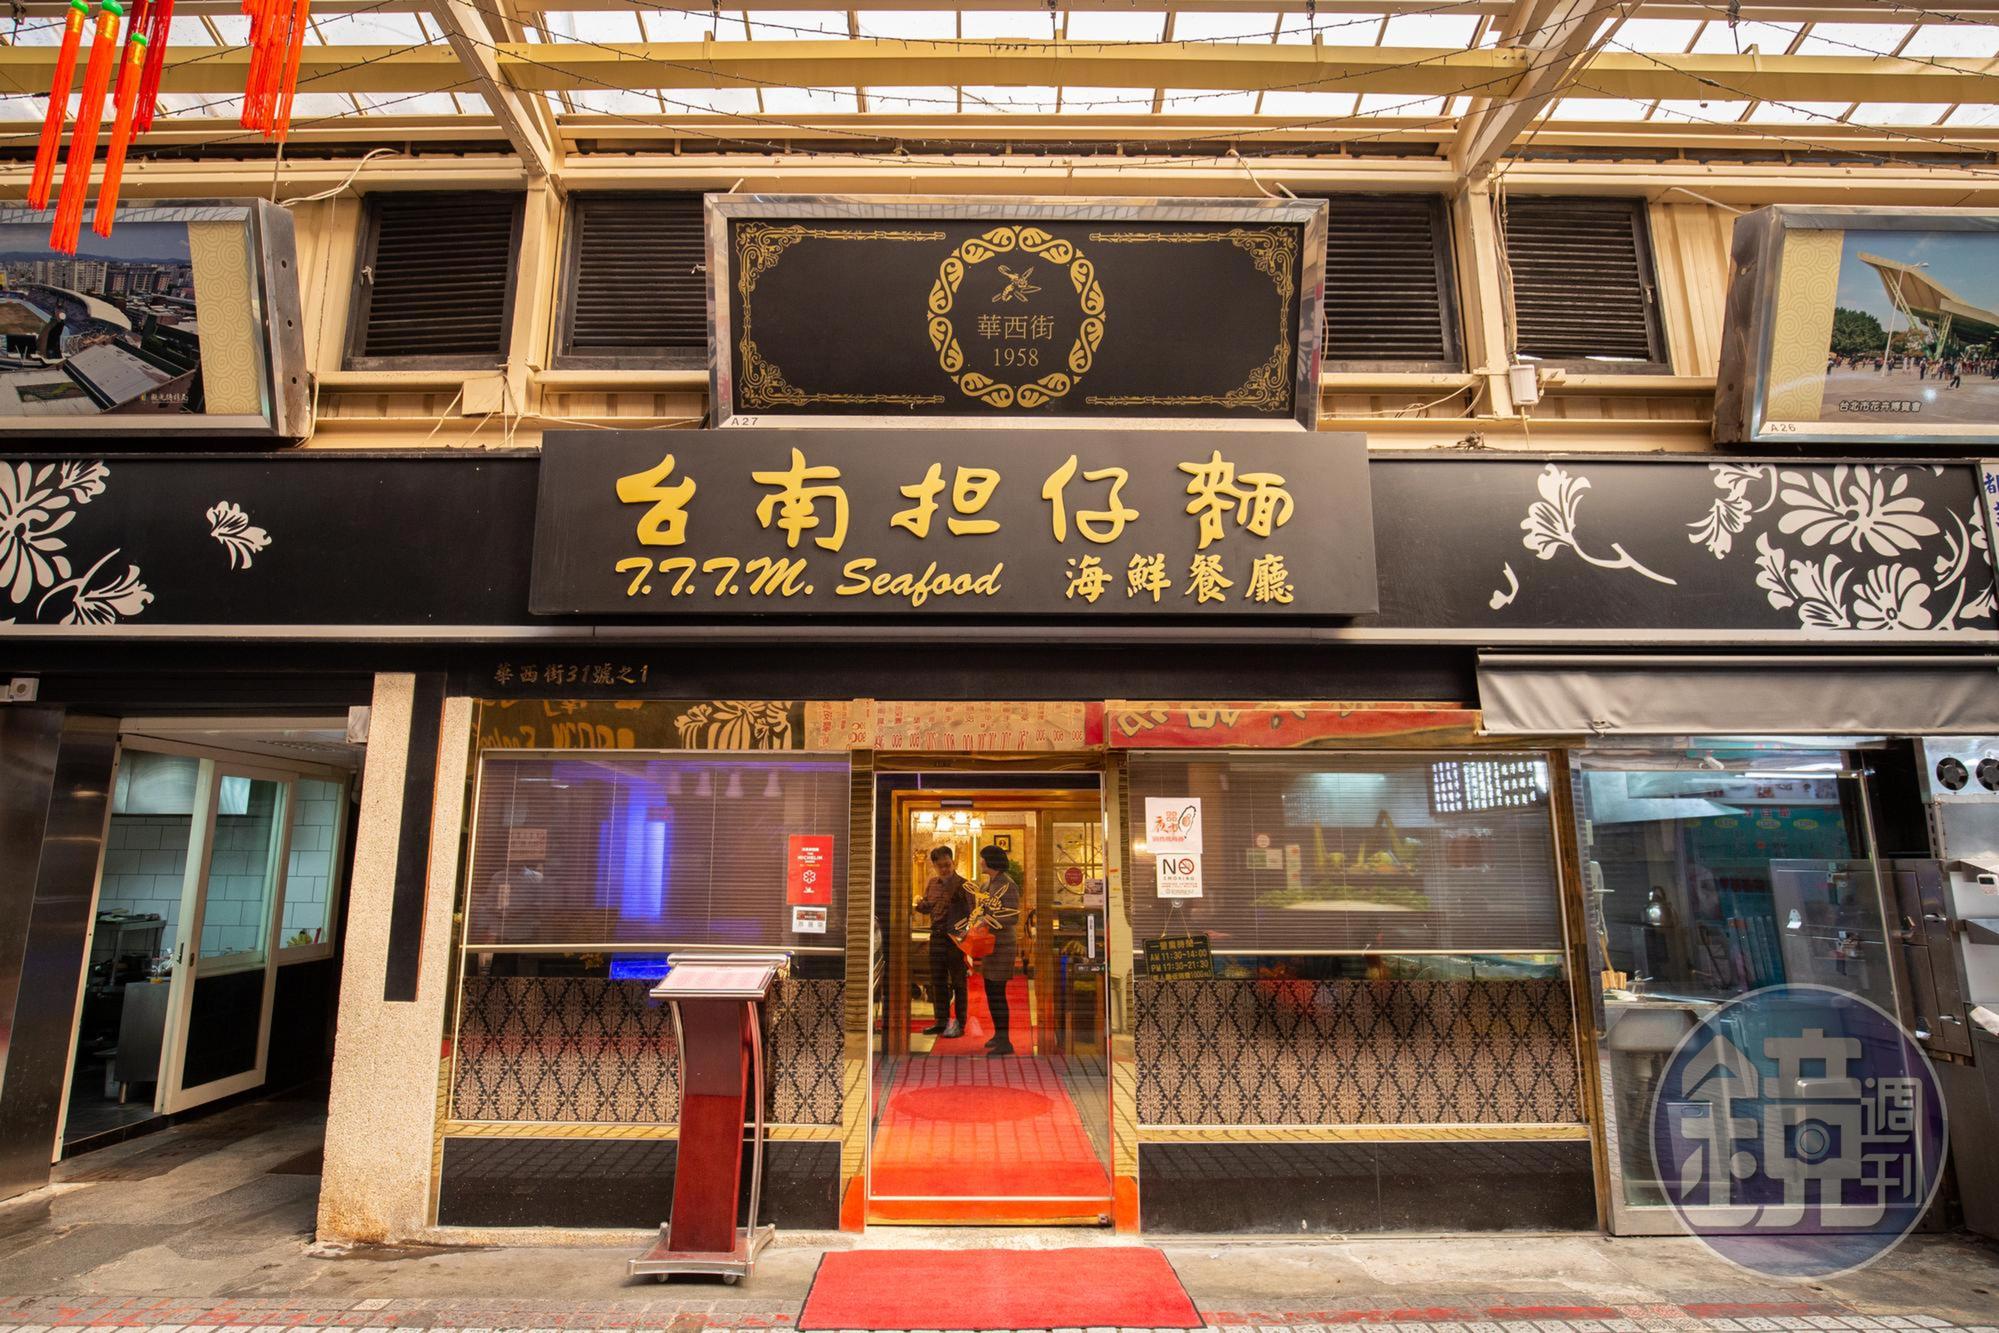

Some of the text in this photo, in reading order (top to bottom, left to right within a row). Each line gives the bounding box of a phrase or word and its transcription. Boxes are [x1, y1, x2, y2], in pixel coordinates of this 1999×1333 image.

[977, 314, 1055, 340] 華西街
[994, 347, 1039, 367] 1958
[731, 417, 759, 426] A27
[1771, 423, 1796, 432] A26
[615, 447, 1295, 552] 台南担仔麵
[835, 557, 1004, 607] Seafood
[1064, 553, 1295, 604] 海鮮餐廳
[494, 662, 648, 685] 華西街31號之1
